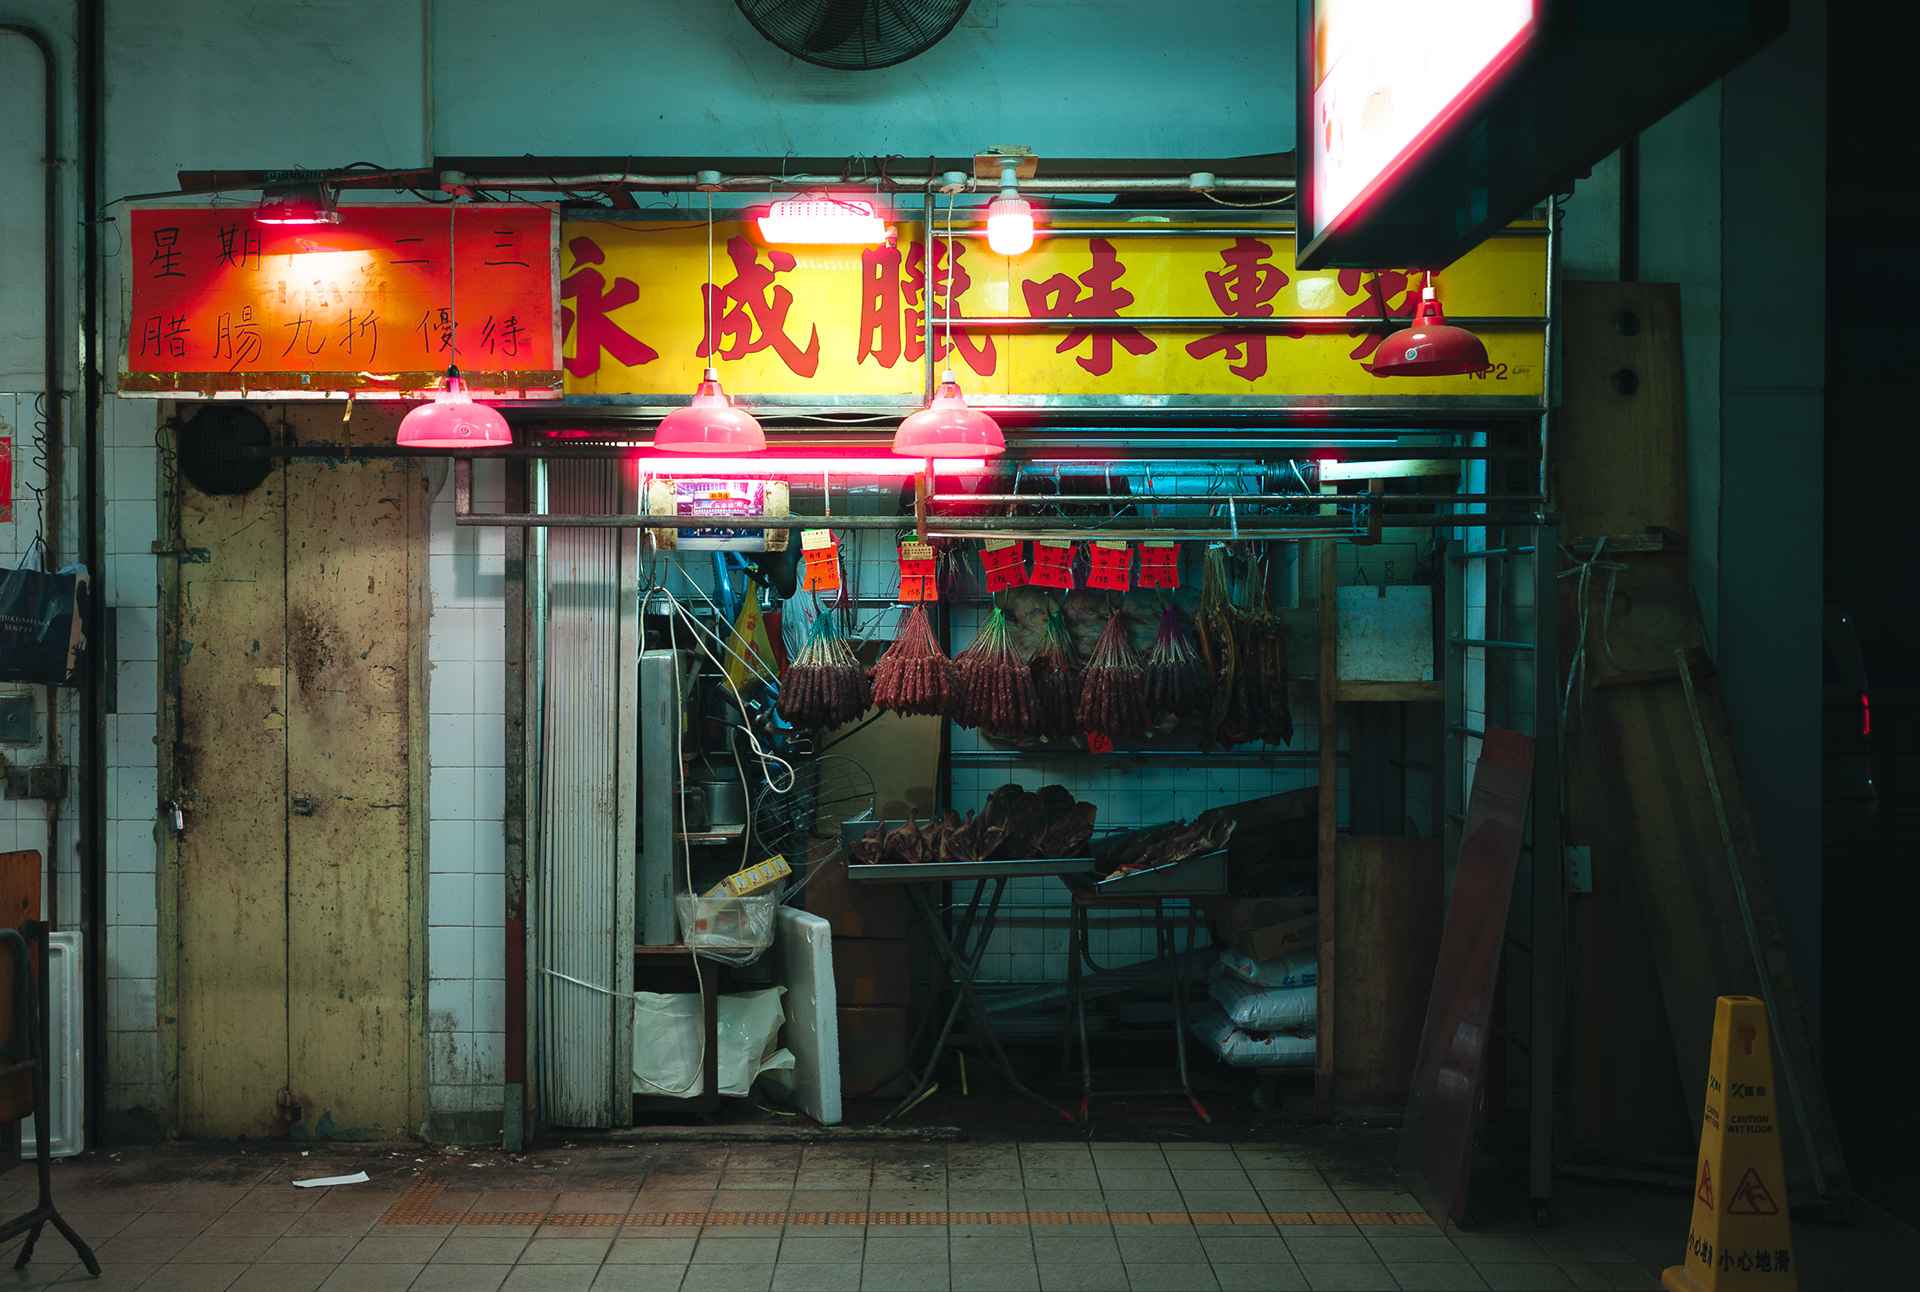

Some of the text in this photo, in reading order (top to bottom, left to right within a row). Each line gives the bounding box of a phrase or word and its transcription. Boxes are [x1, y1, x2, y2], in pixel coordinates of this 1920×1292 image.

[1384, 560, 1395, 586] TICKS
[1094, 575, 1109, 583] 198
[908, 588, 920, 596] 158
[0, 614, 50, 626] JUKUSHIMA
[1731, 1115, 1769, 1124] CAUTION
[1727, 1125, 1773, 1133] WET FLOOR
[1718, 1249, 1790, 1273] 小心地滑
